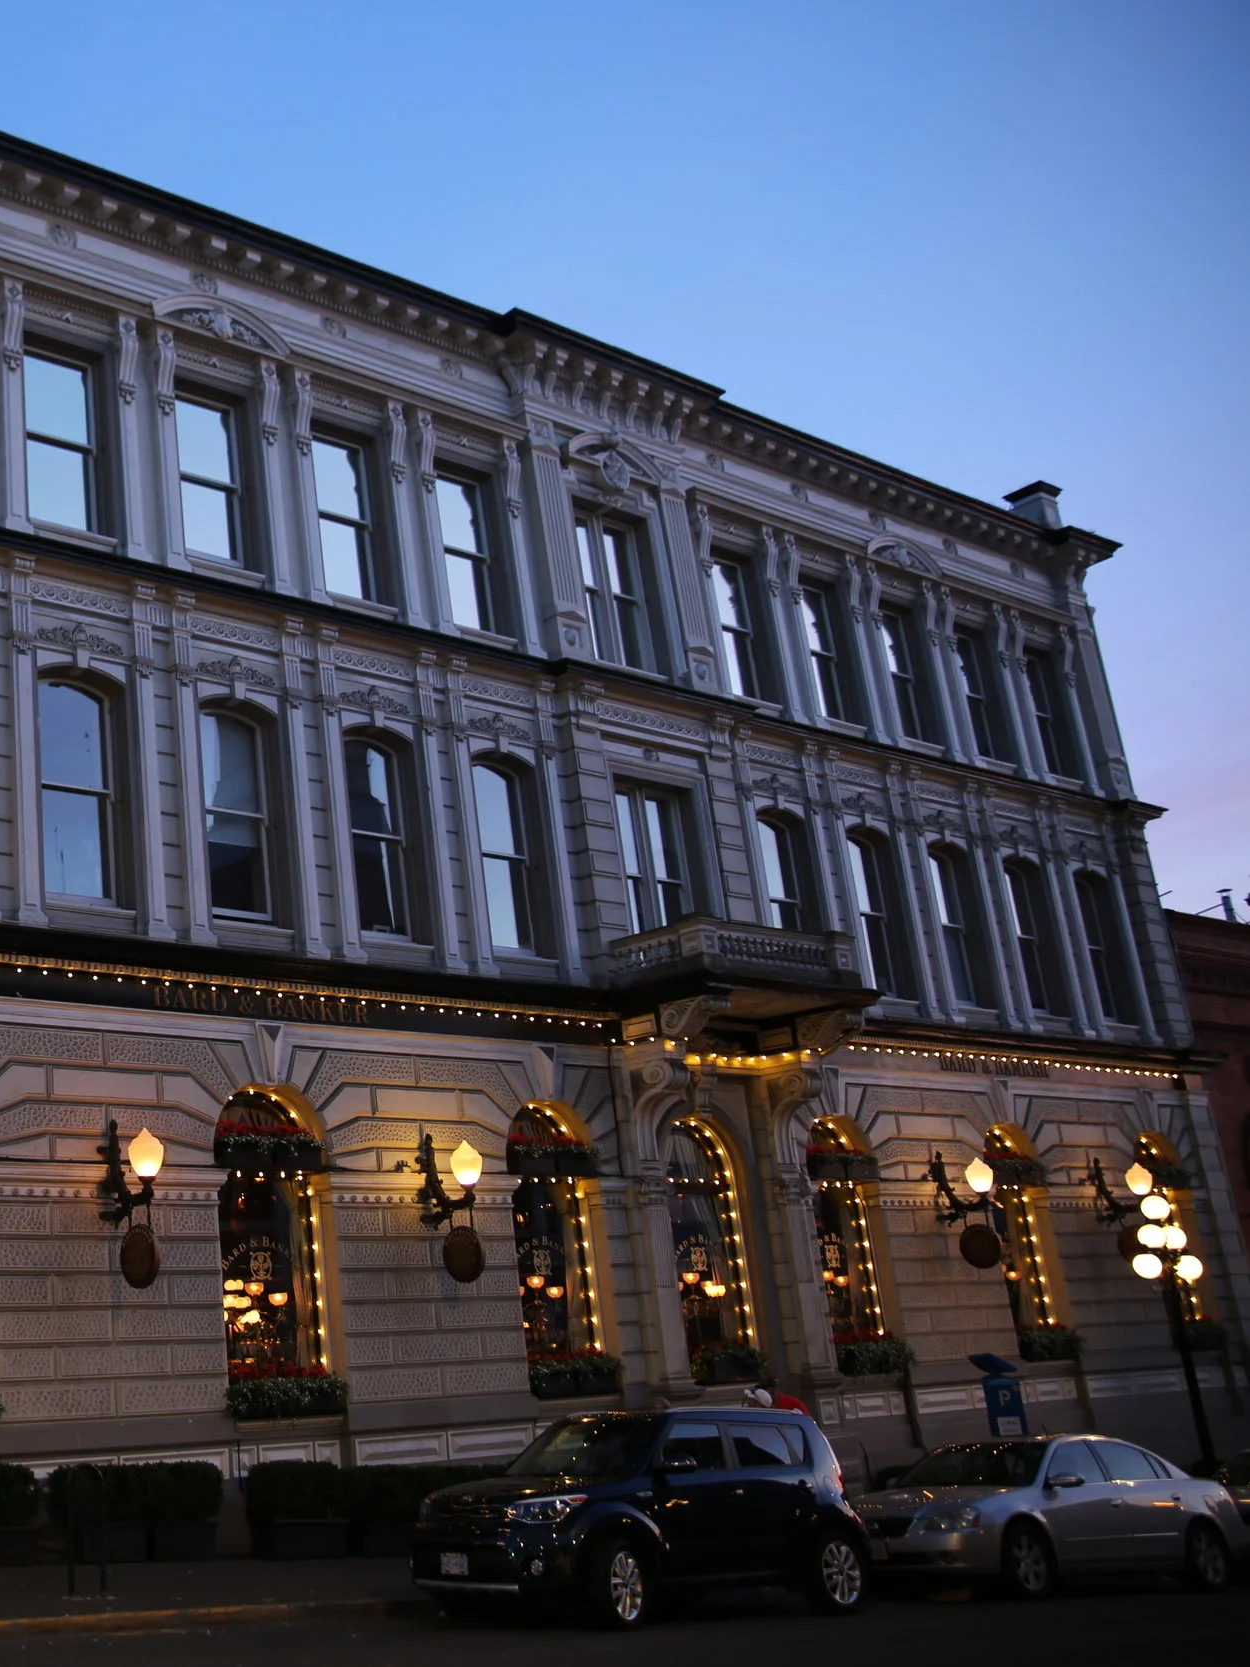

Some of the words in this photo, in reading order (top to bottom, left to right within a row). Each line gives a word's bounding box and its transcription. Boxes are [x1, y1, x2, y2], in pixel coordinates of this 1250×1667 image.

[153, 985, 228, 1013] BARD
[237, 994, 257, 1016] &
[263, 995, 371, 1026] BANKER
[221, 1242, 247, 1272] BARD
[250, 1236, 259, 1248] &
[532, 1237, 540, 1246] &
[997, 1389, 1012, 1408] P
